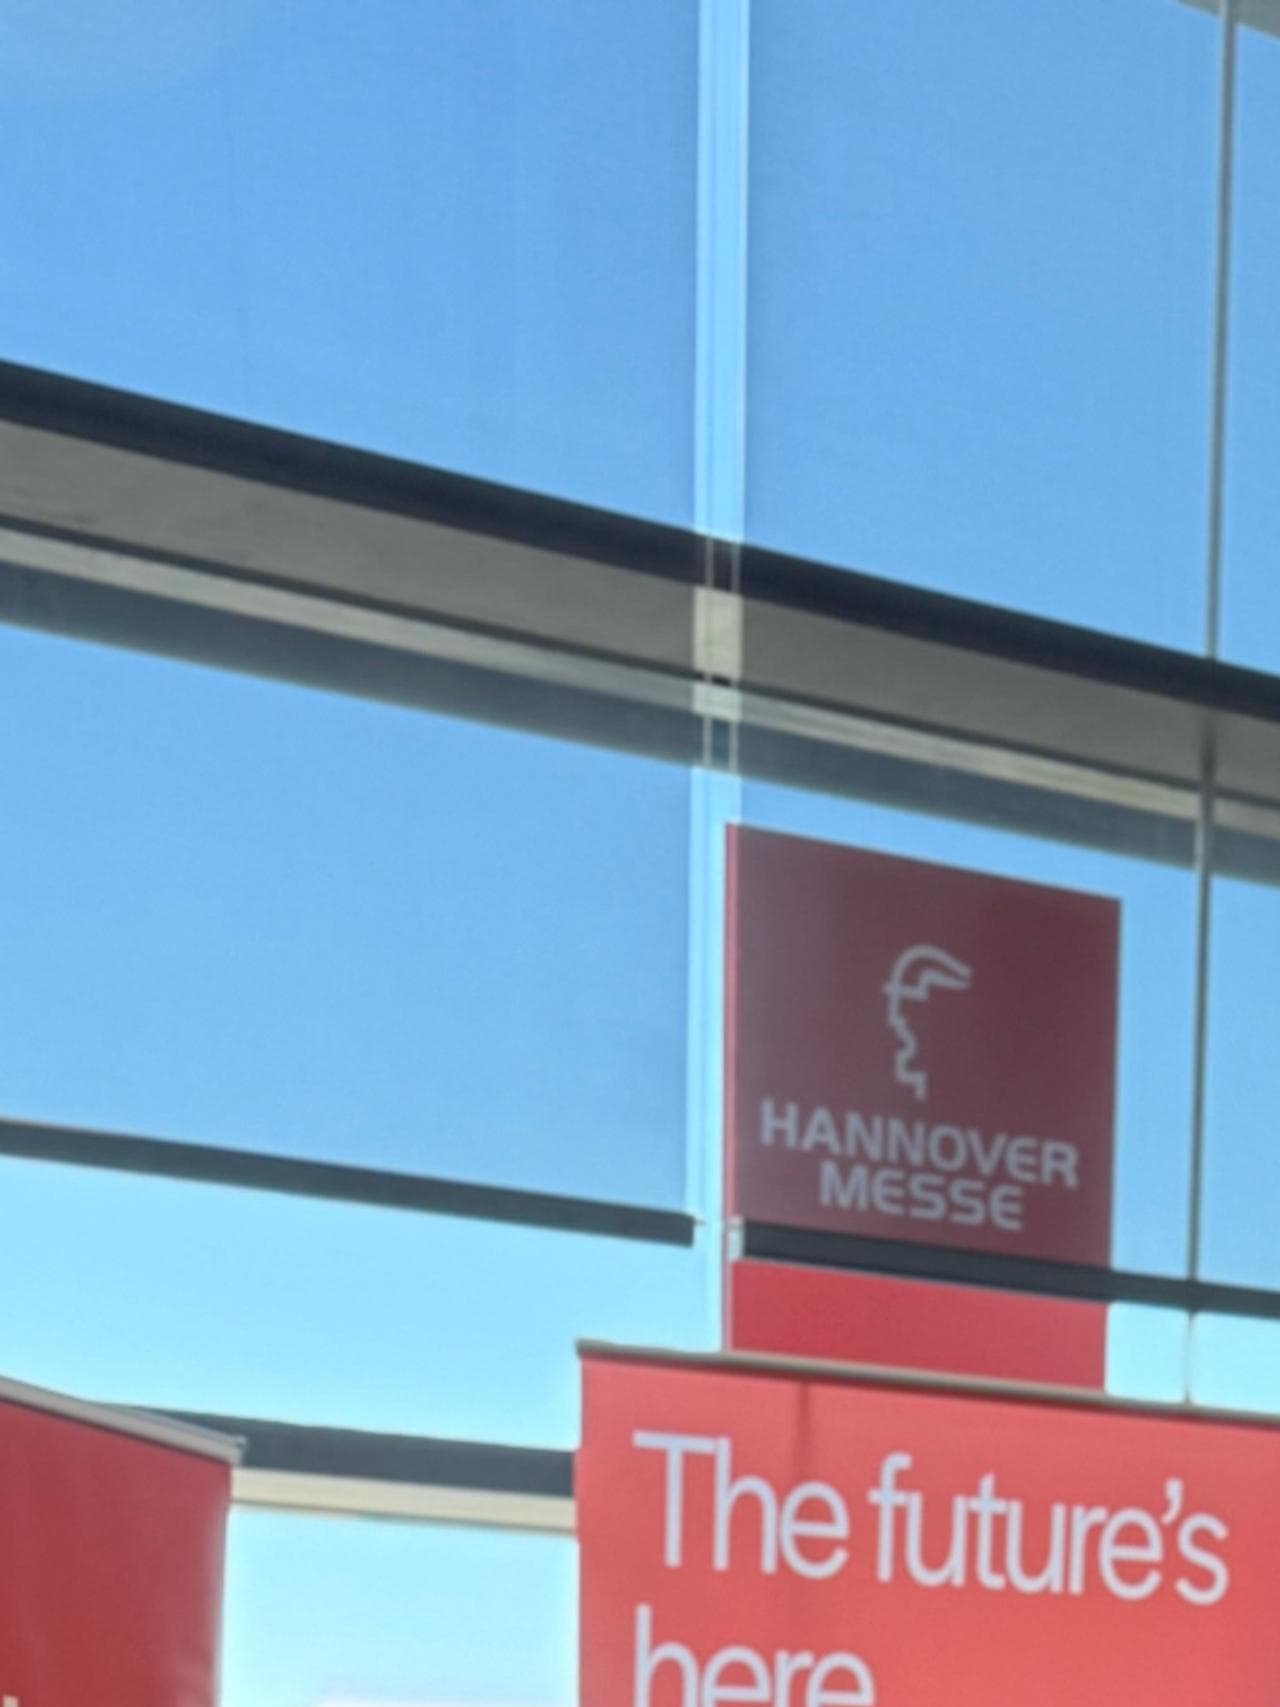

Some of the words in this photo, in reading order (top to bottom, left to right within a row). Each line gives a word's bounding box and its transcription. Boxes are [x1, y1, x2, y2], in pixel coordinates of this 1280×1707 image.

[760, 1099, 1079, 1190] HANNOVER
[821, 1160, 1024, 1231] MESSE
[633, 1431, 850, 1578] The
[868, 1453, 1229, 1605] future's
